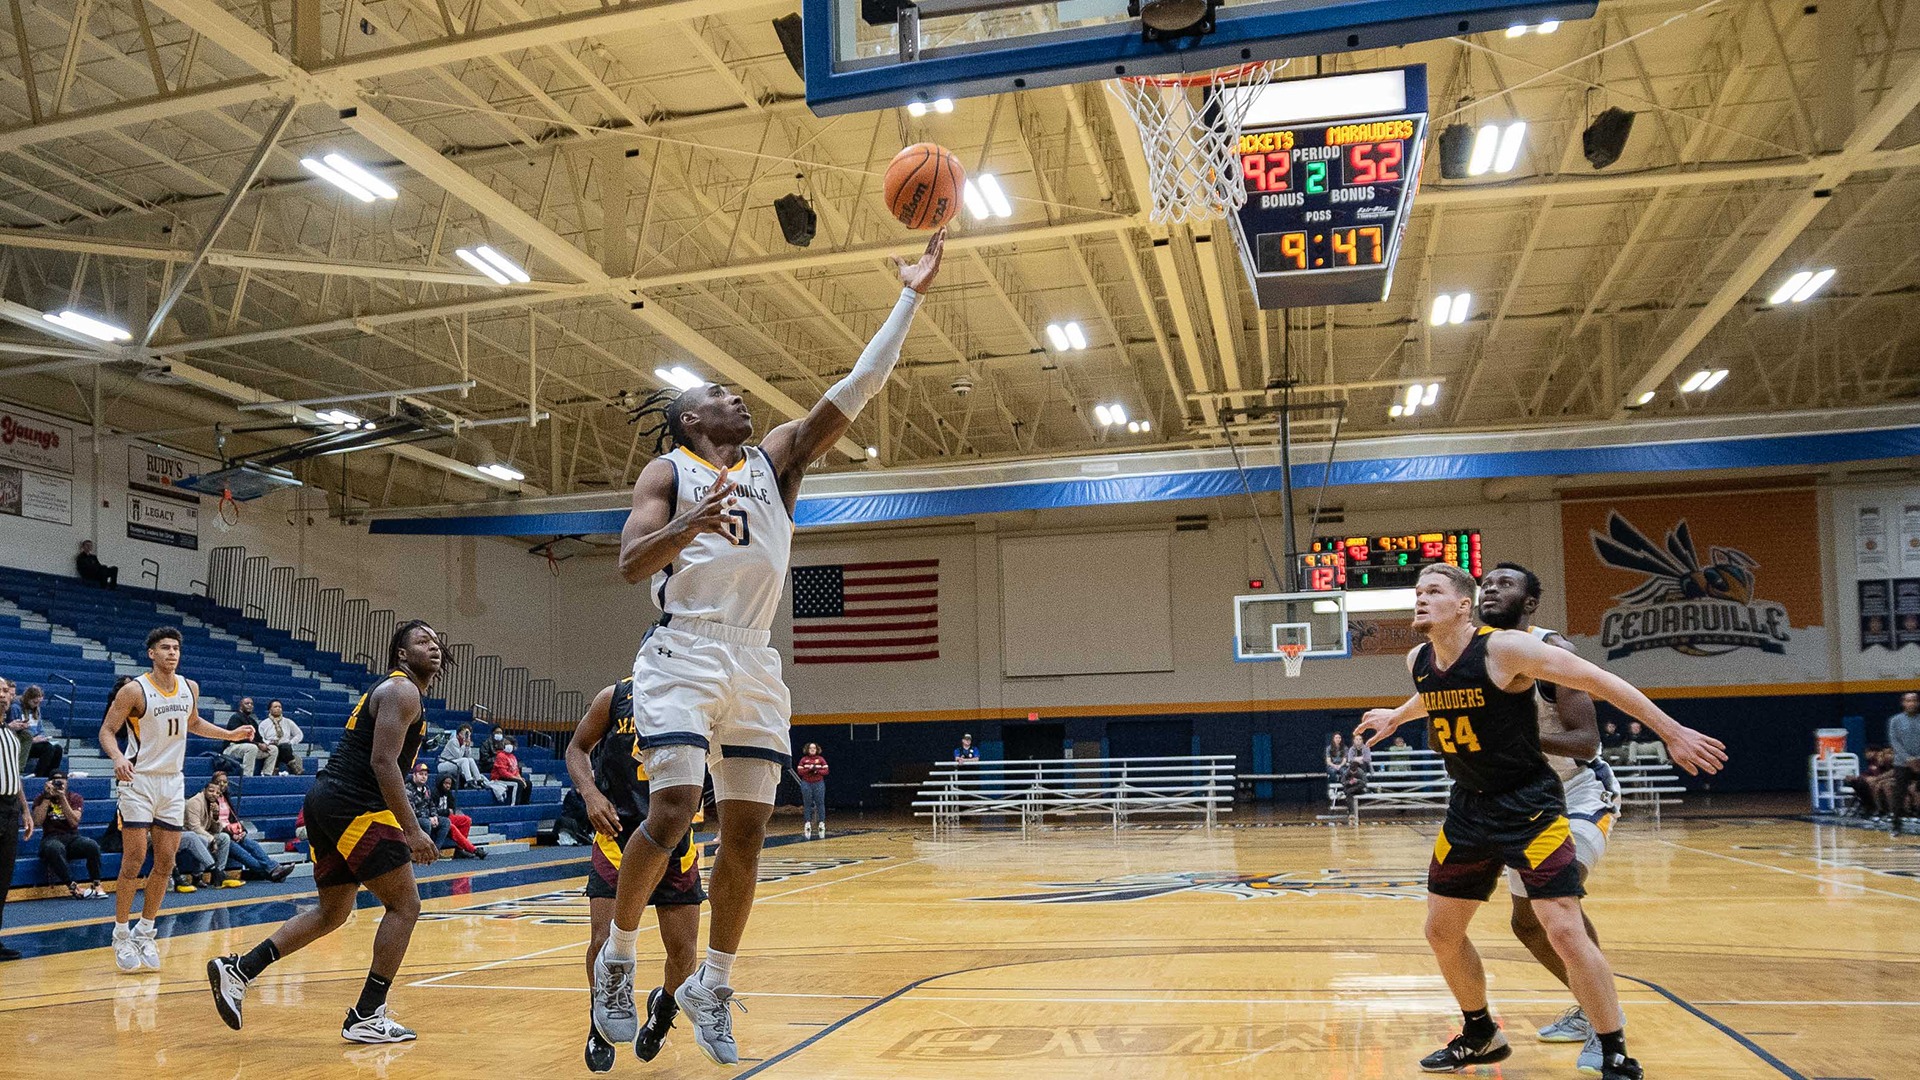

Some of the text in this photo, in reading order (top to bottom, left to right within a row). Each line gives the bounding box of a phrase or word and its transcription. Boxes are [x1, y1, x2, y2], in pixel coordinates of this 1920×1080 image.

[1326, 120, 1413, 146] MARAUDERS
[1293, 145, 1340, 161] PERIOD
[1350, 142, 1402, 183] 52
[1242, 152, 1290, 191] 92
[1307, 162, 1325, 192] 2
[1262, 193, 1304, 208] BONUS
[1331, 186, 1375, 203] BONUS
[1306, 210, 1332, 222] POSS
[1281, 227, 1381, 269] 9:47
[1, 415, 60, 450] Young's
[146, 454, 183, 478] RUDY'S
[145, 506, 175, 522] LEGACY
[1348, 546, 1369, 561] 92
[1379, 536, 1417, 551] 9:47
[1423, 542, 1443, 558] 52
[1312, 568, 1333, 590] 12
[1602, 604, 1790, 647] CEDARVILLE
[154, 704, 189, 717] CEDARVILLE
[168, 718, 179, 736] 11
[1433, 716, 1481, 753] 24
